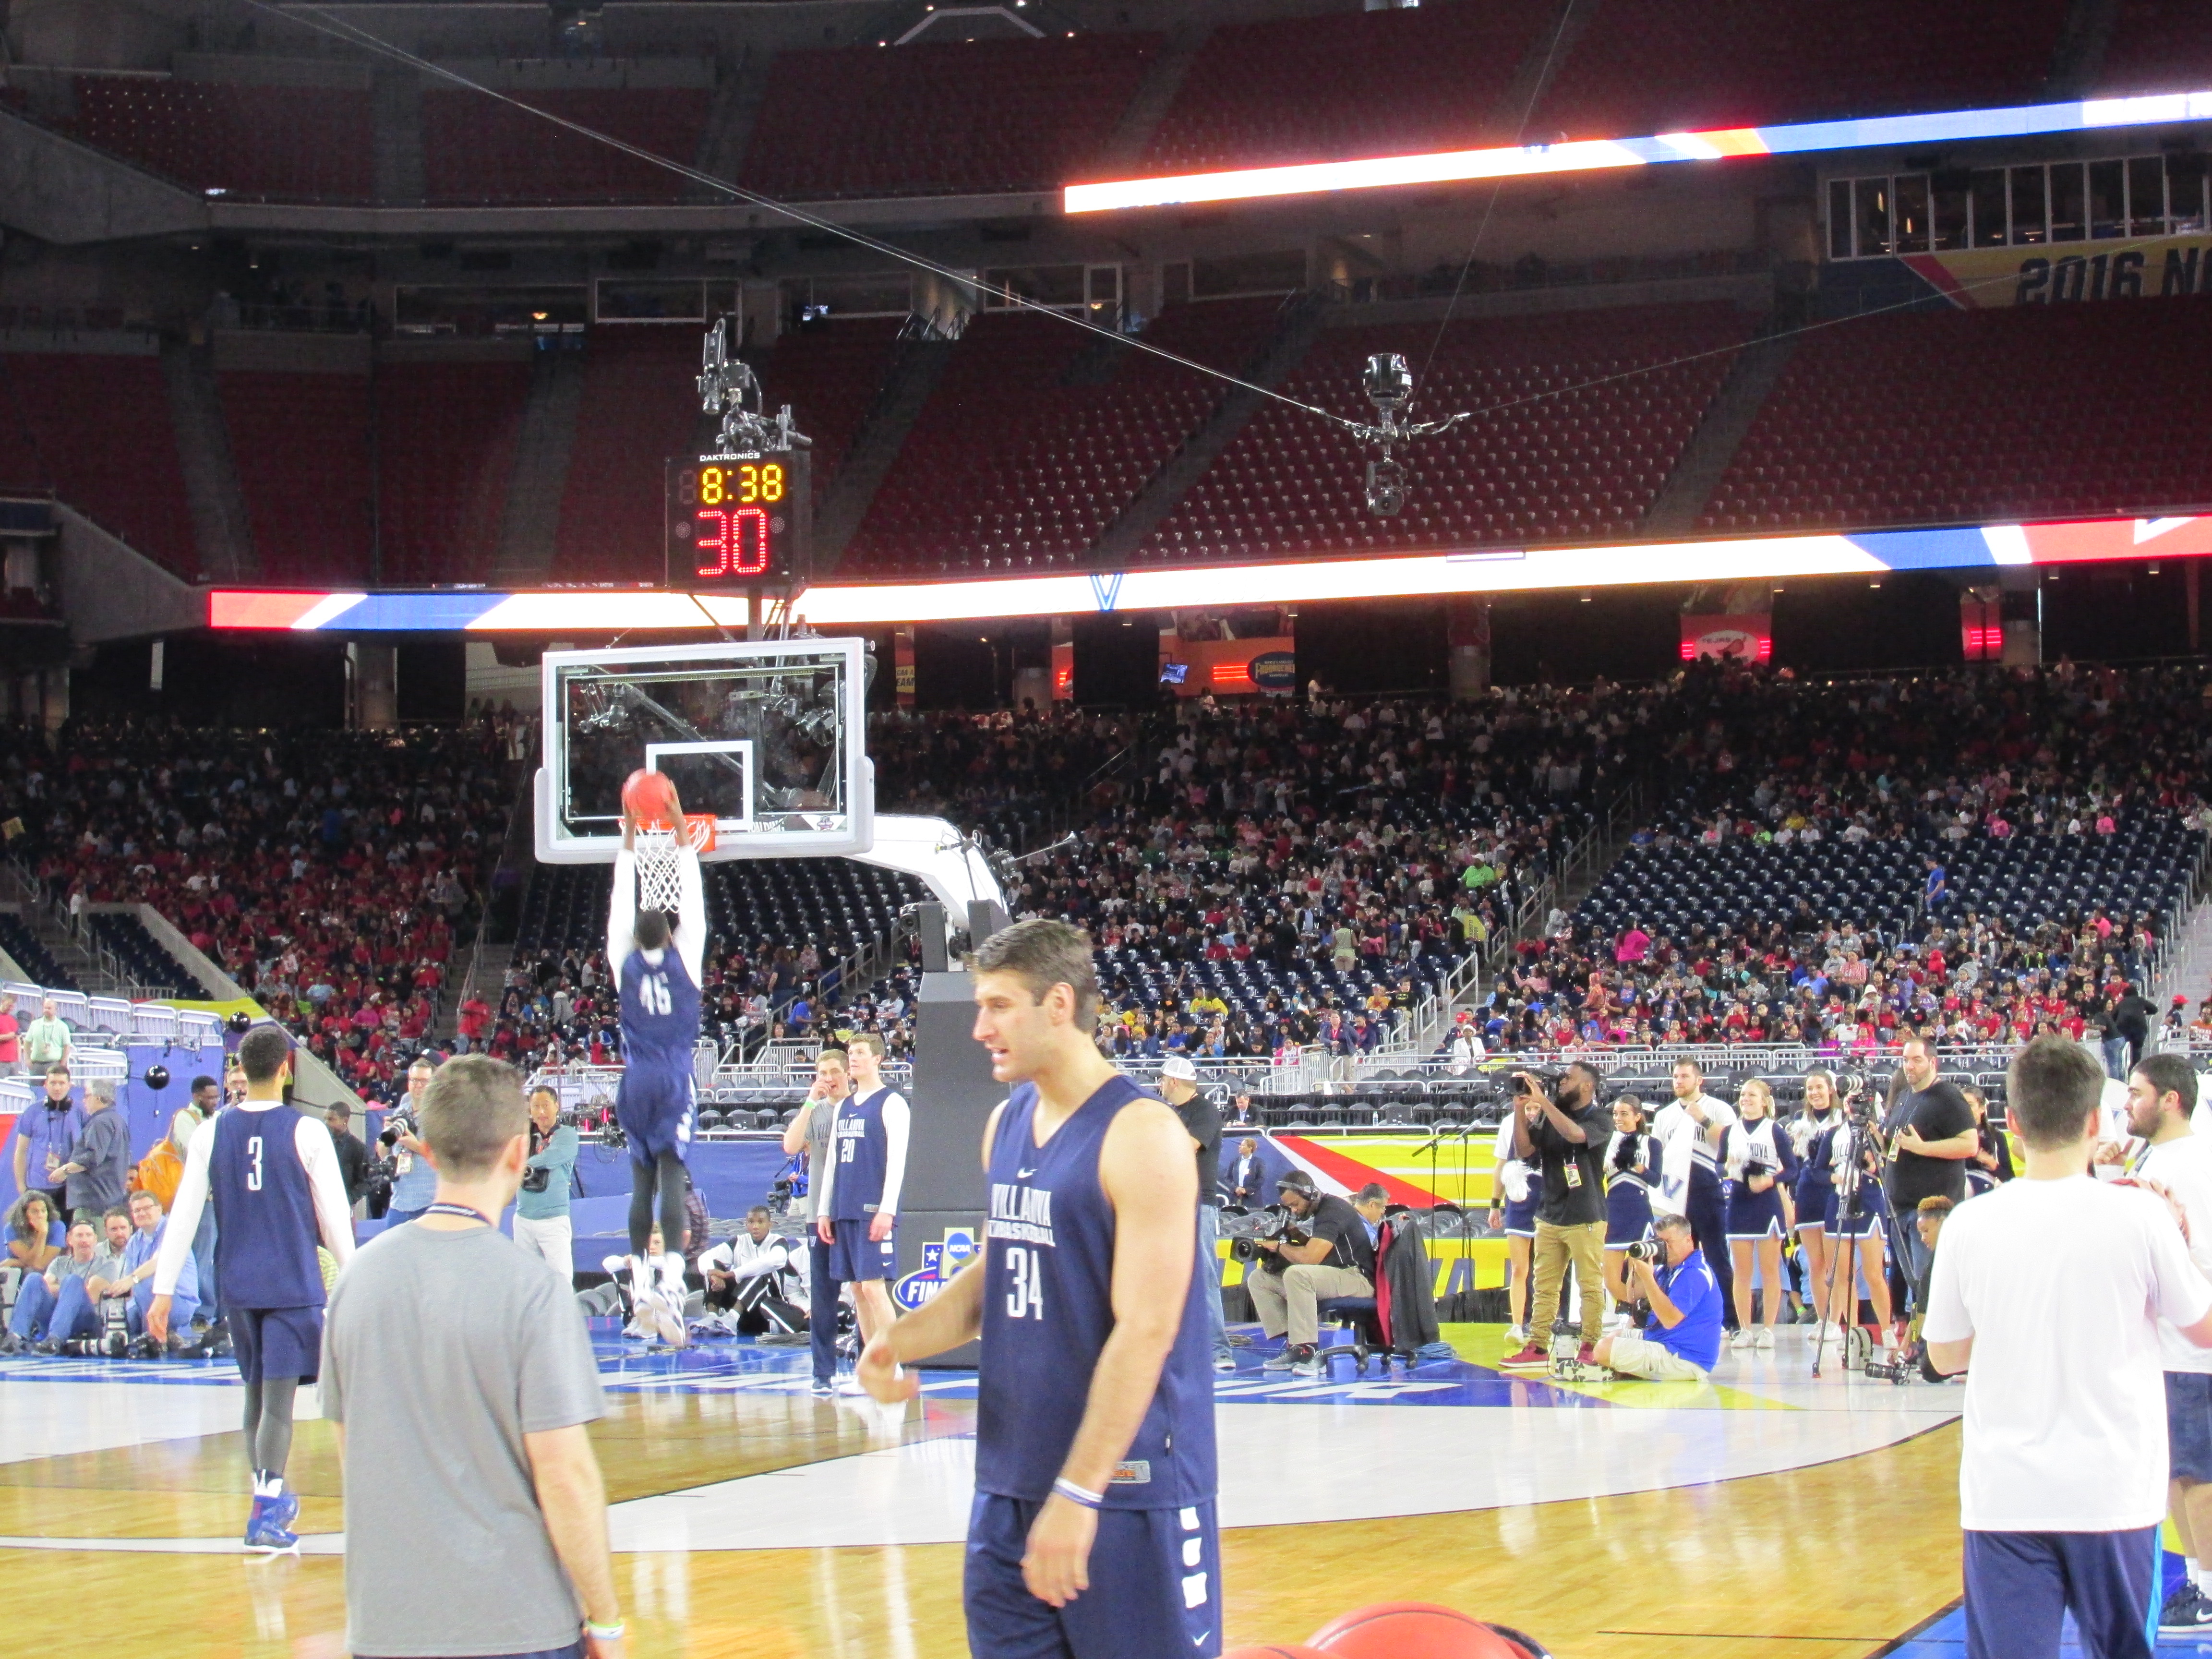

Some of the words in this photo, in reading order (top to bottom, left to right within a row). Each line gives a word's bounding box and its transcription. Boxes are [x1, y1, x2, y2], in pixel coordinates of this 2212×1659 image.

[2016, 250, 2144, 305] 2016
[699, 452, 760, 461] DAKTRONICS
[702, 464, 782, 505] 8:38
[698, 508, 766, 575] 30
[248, 1136, 263, 1191] 3
[841, 1139, 855, 1162] 20
[949, 1244, 971, 1252] NCAA
[907, 1281, 948, 1302] FIN
[1006, 1247, 1044, 1320] 34
